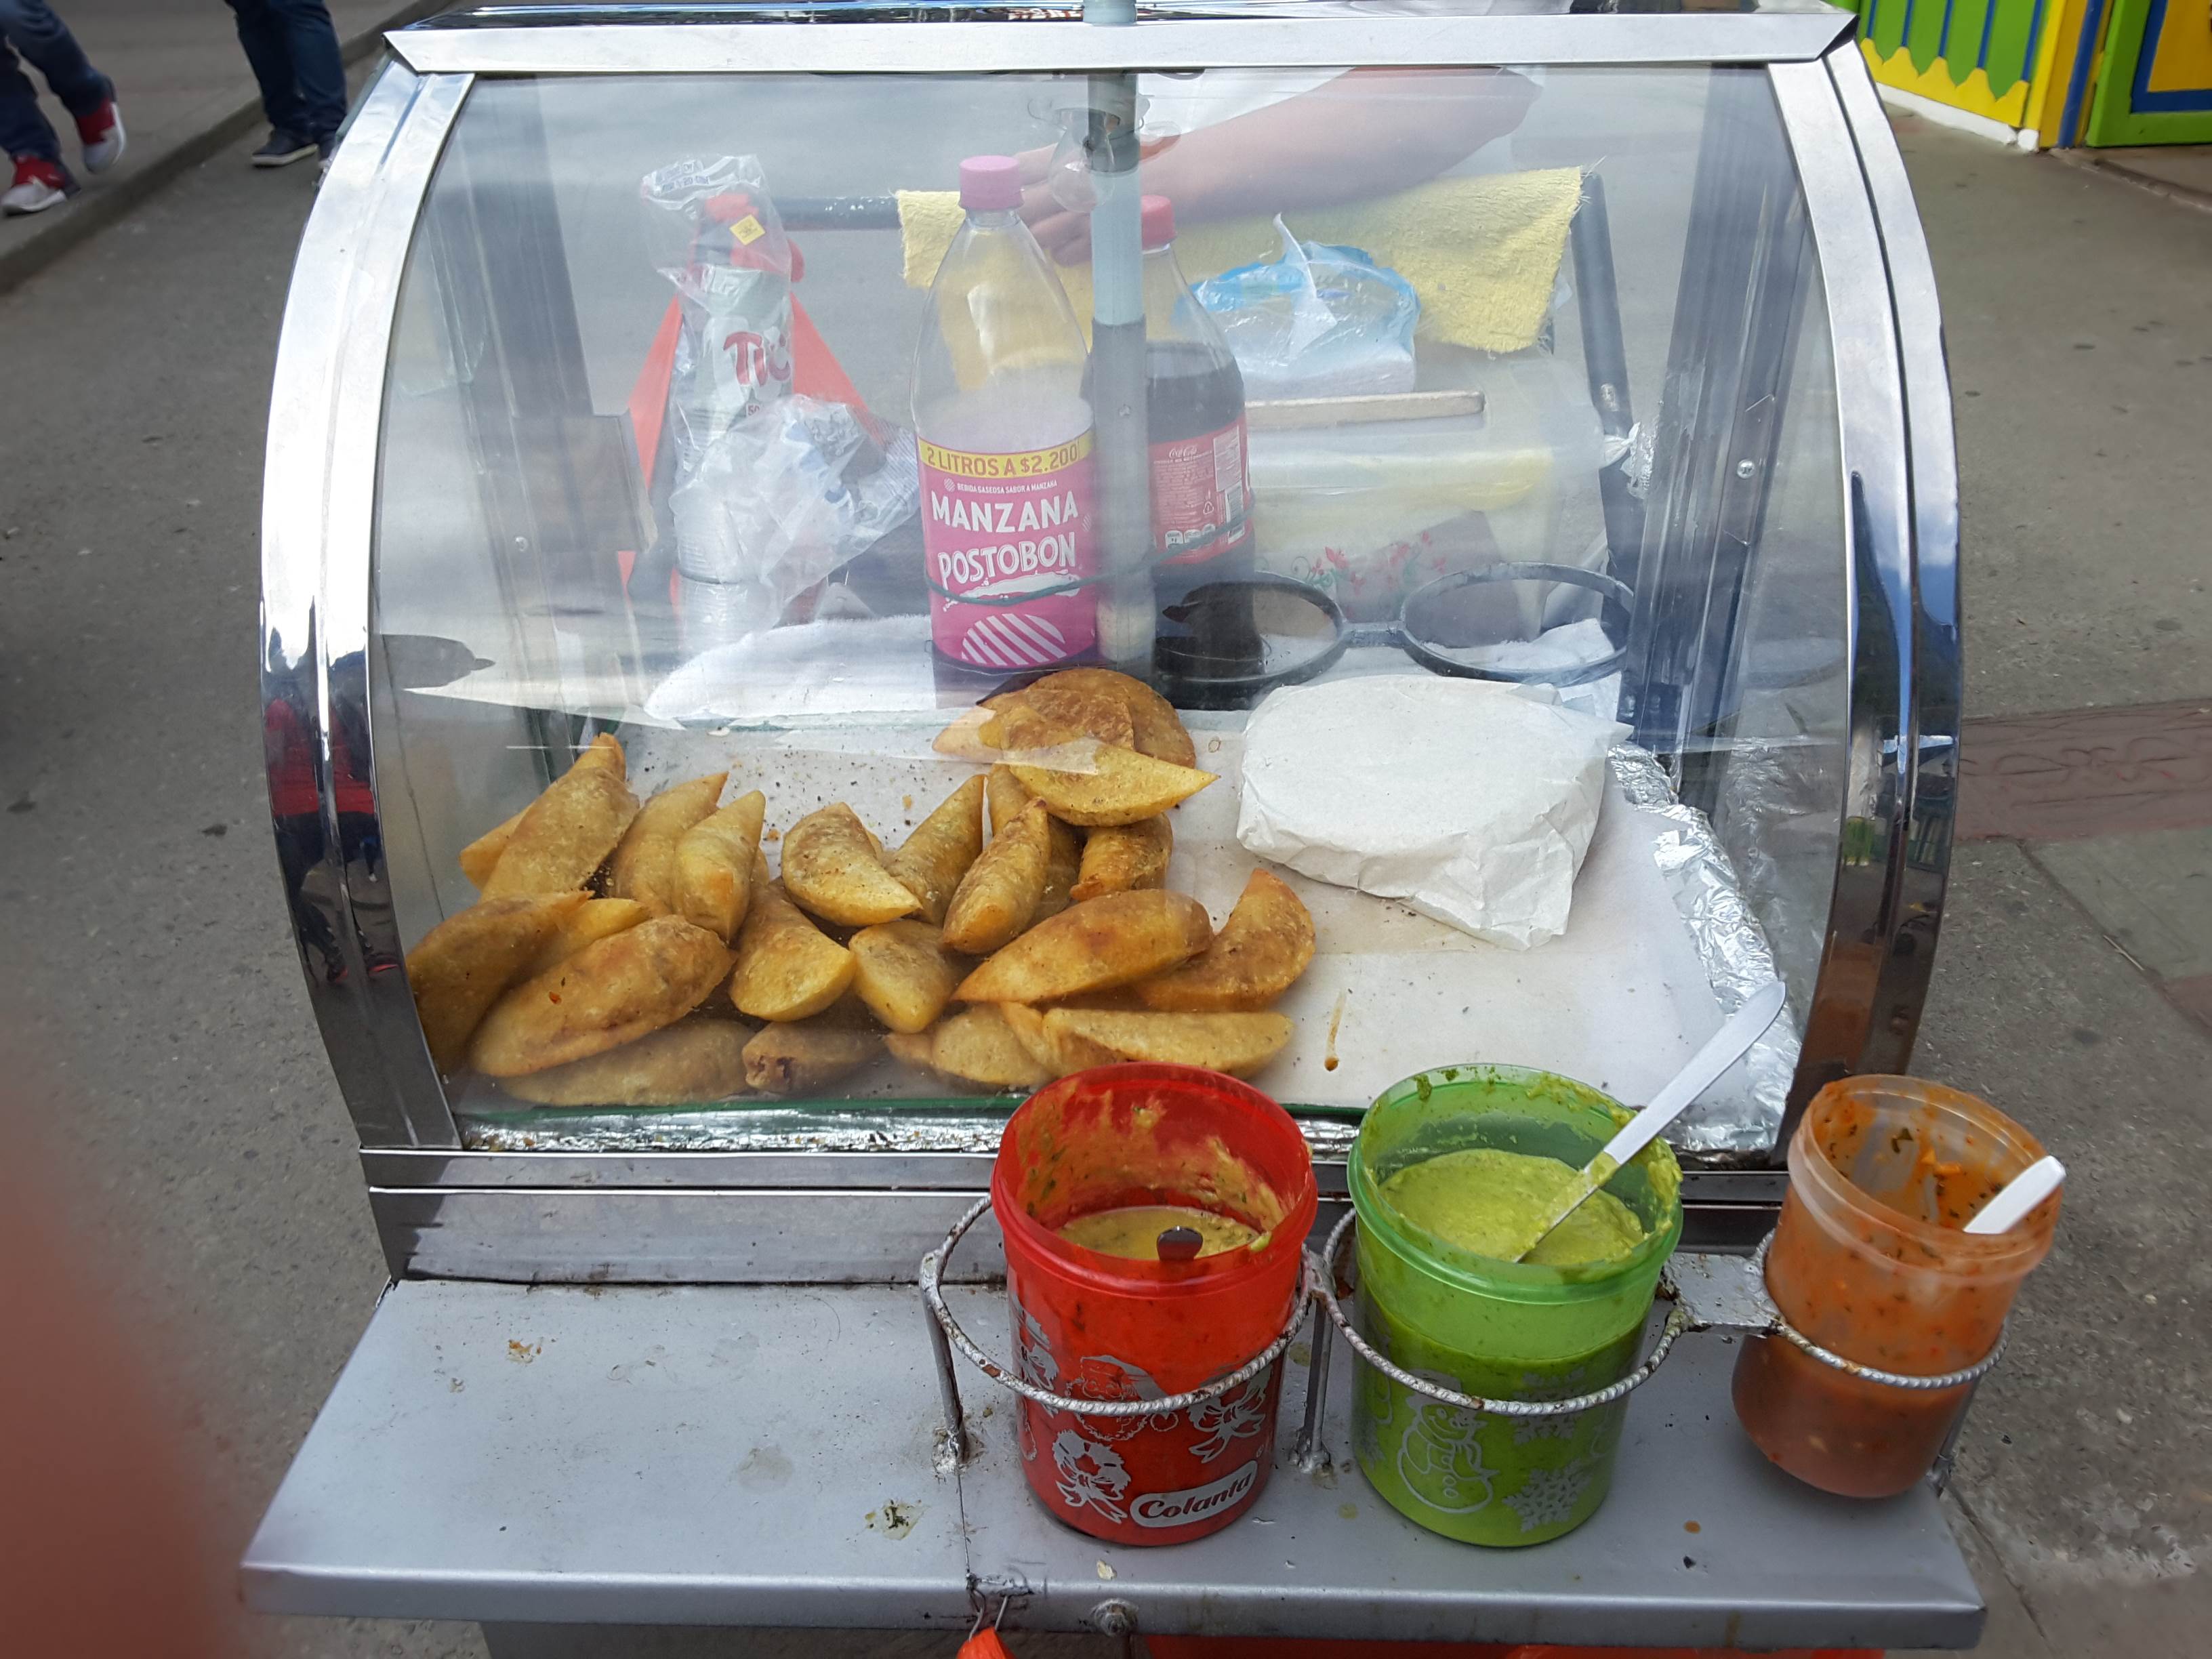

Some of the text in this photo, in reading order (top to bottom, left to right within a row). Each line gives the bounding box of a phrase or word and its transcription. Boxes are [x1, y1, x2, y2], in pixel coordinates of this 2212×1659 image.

[926, 443, 1078, 476] 2 LITROS A $2.200
[957, 483, 977, 493] BEBIDA
[1006, 485, 1025, 493] SABOR
[1031, 480, 1058, 491] MANZANA
[931, 490, 1079, 533] MANZANA
[937, 531, 1076, 591] POSTOBON
[1138, 1472, 1254, 1519] Colanta
